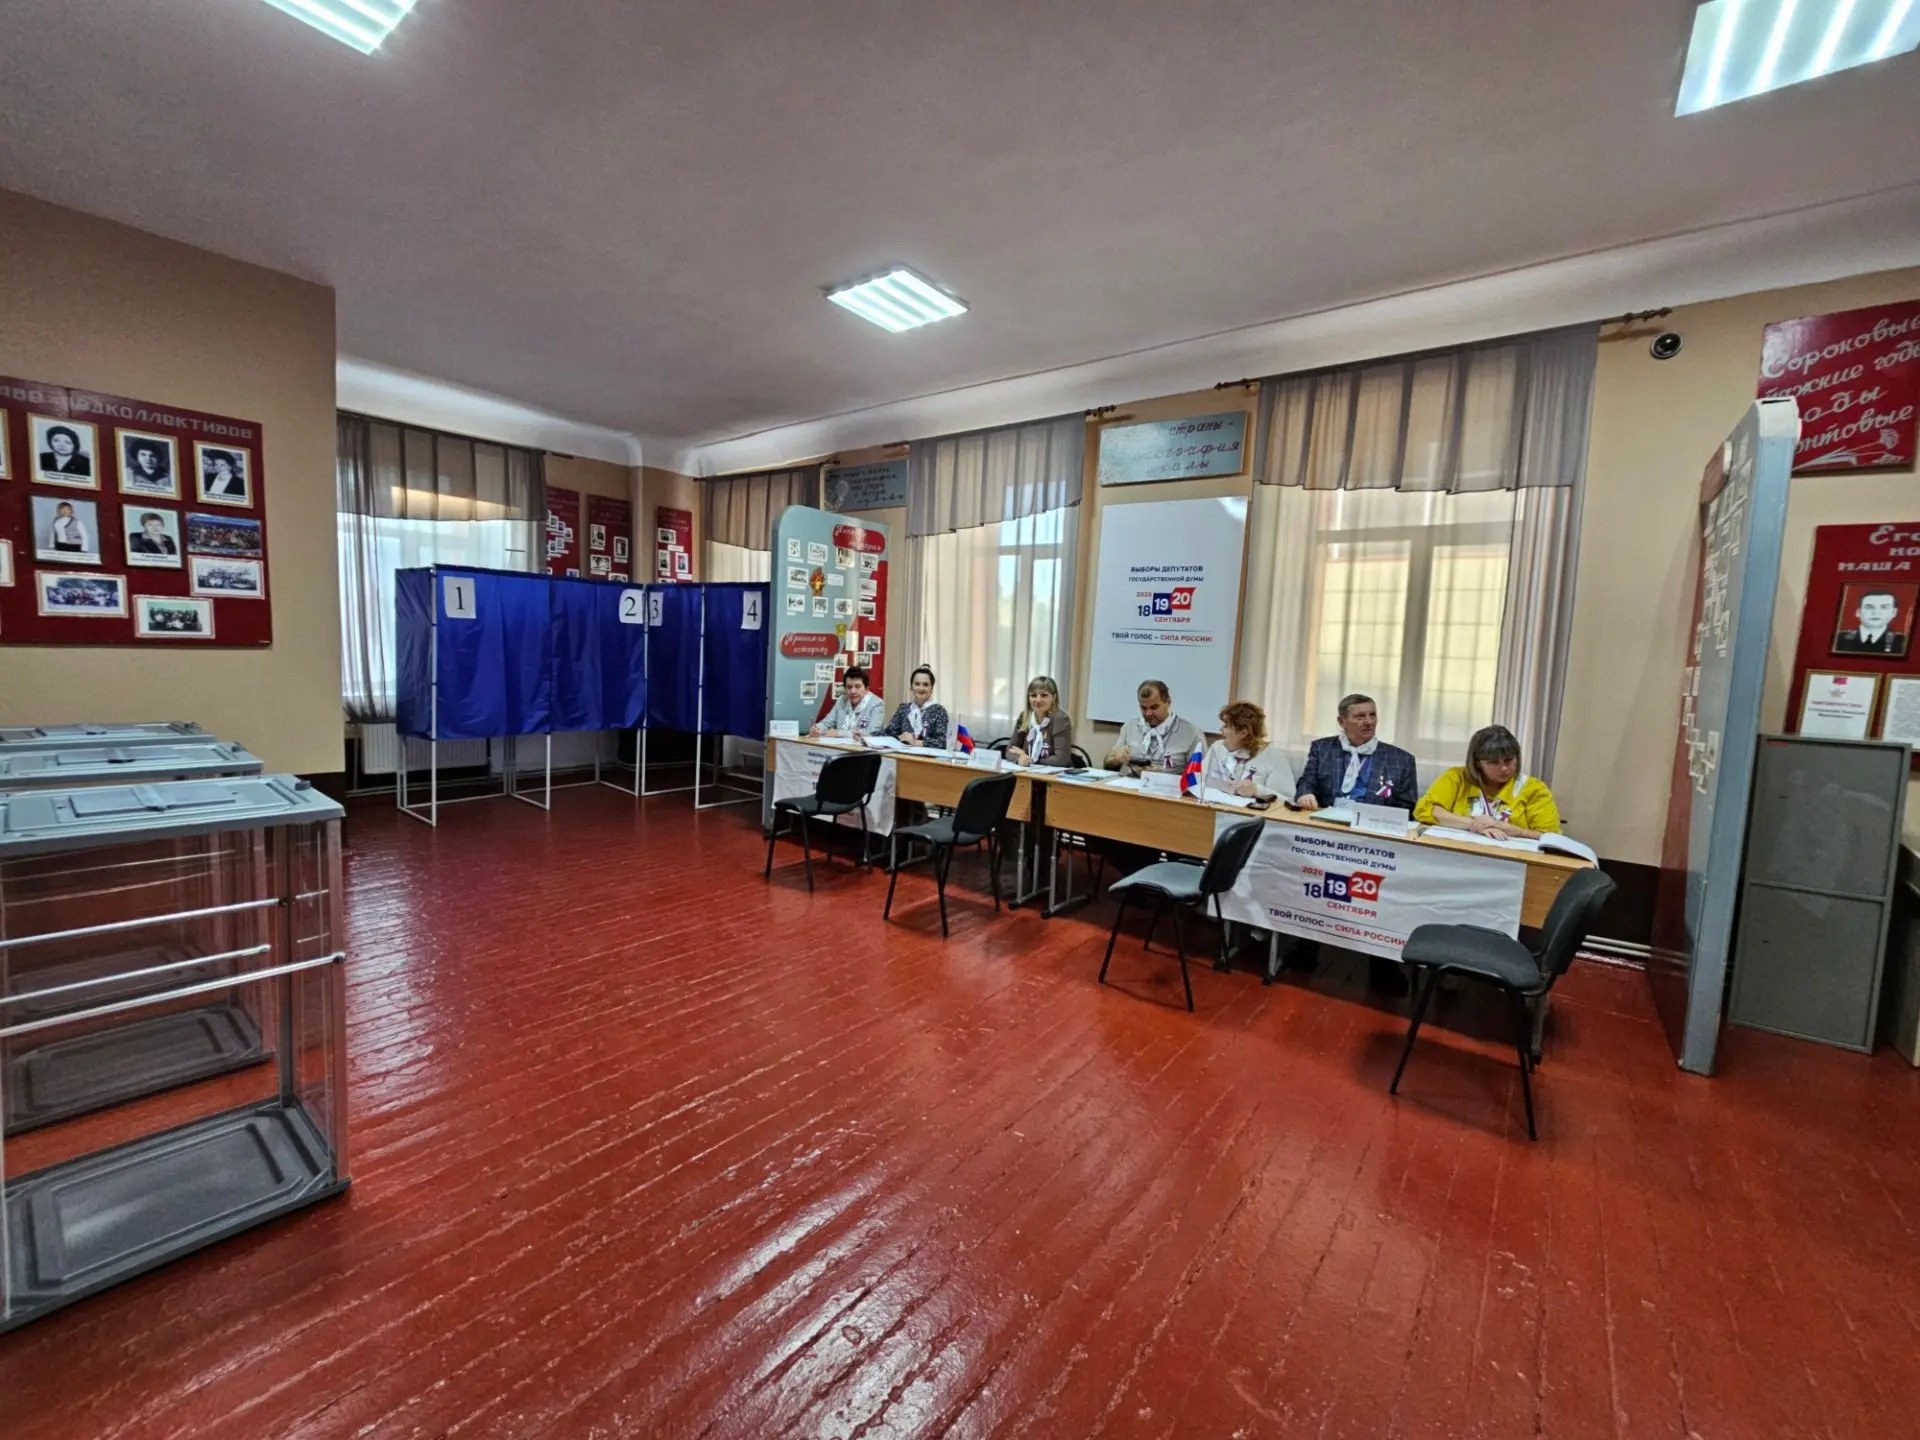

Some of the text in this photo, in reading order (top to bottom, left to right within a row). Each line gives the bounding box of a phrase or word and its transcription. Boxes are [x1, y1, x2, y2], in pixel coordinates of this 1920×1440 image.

[1801, 385, 1888, 423] оды
[1837, 561, 1912, 571] НАША
[456, 586, 465, 610] 1
[624, 596, 637, 616] 2
[1137, 592, 1190, 616] 18 19 20
[651, 599, 660, 619] 3
[747, 599, 758, 621] 4
[1111, 631, 1129, 639] ТВОЙ
[1294, 834, 1395, 859] ВЫБОРЫ ДЕПУТАТОВ
[1291, 846, 1396, 871] ГОСУДАРСТВЕННОЙ ДУМЫ
[1302, 866, 1323, 876] 2026
[1303, 877, 1378, 898] 18 19 20
[1327, 901, 1377, 917] СЕНТЯБРЯ
[1268, 907, 1292, 919] ТВОЙ
[1294, 914, 1325, 927] ГОЛОС
[1335, 923, 1361, 936] СИЛА
